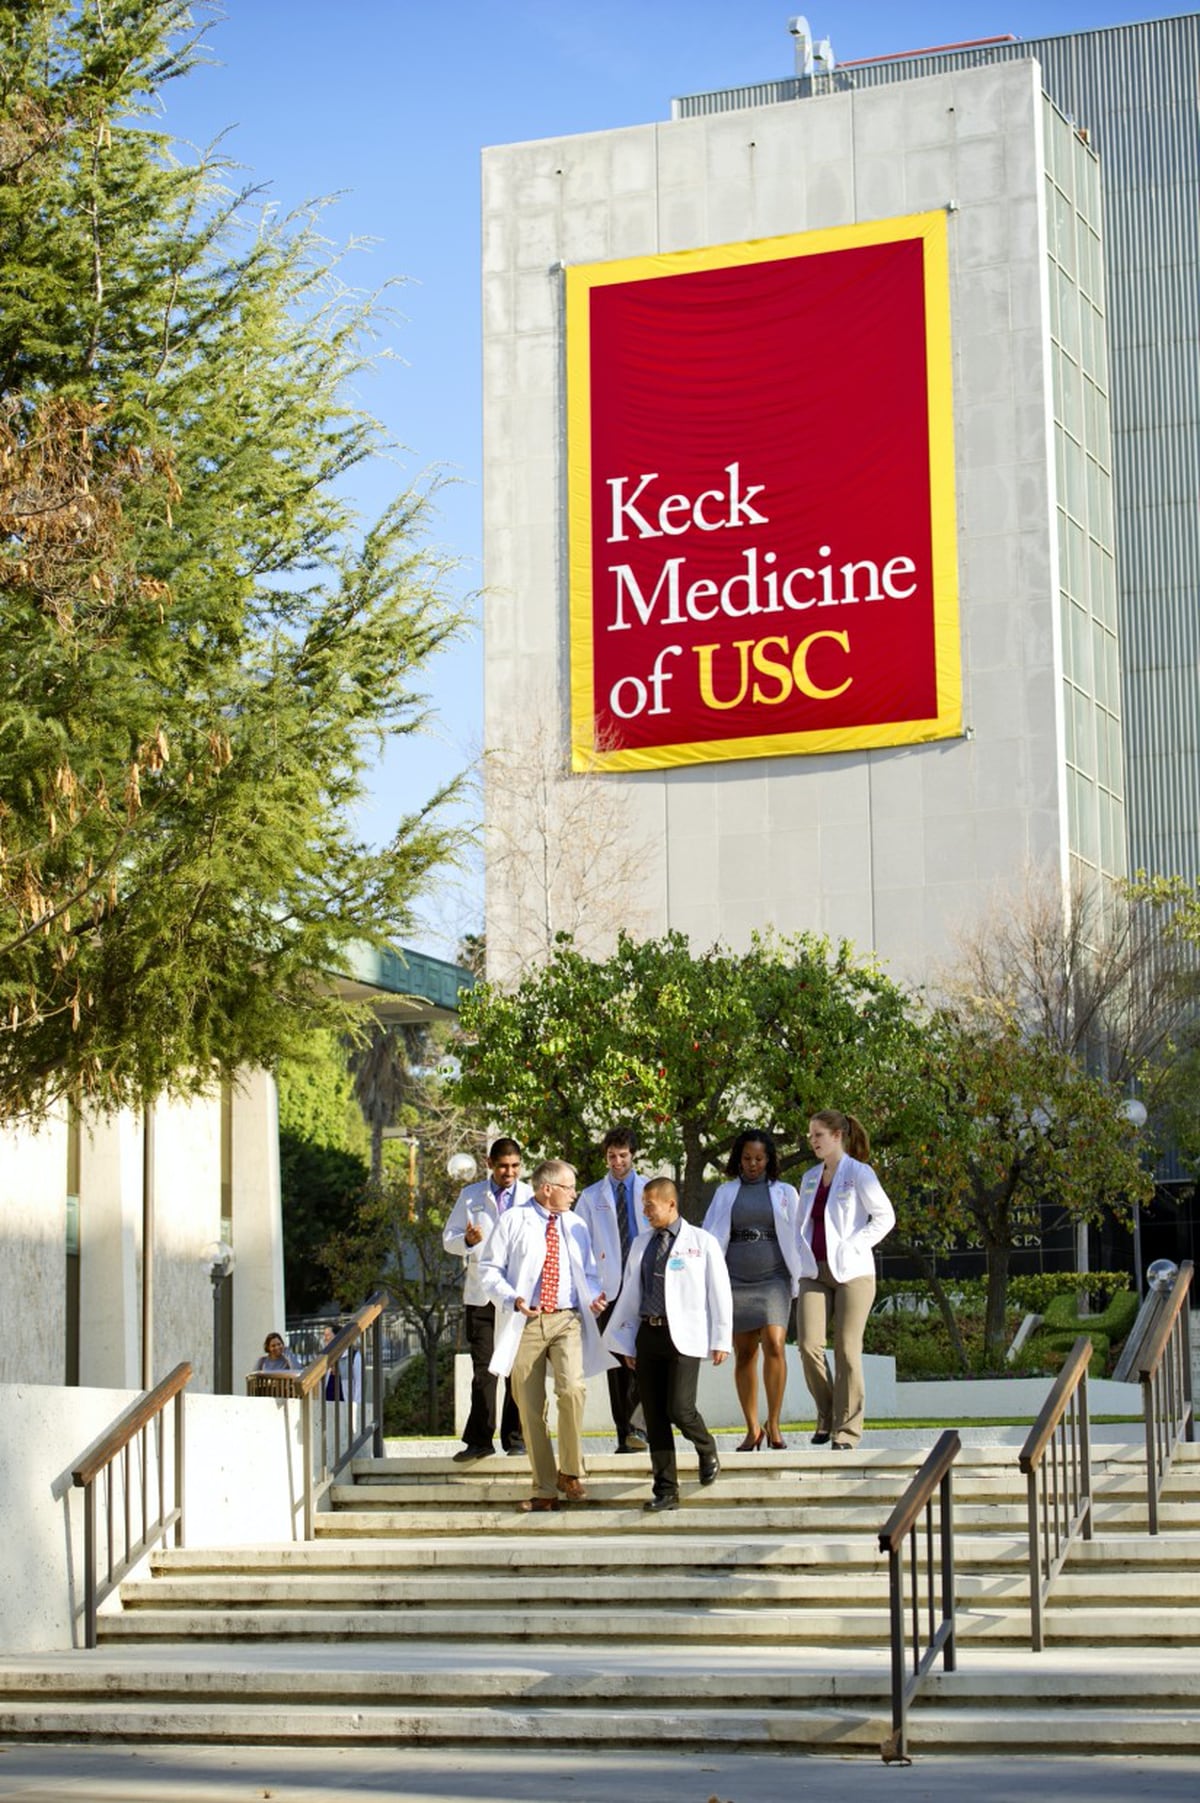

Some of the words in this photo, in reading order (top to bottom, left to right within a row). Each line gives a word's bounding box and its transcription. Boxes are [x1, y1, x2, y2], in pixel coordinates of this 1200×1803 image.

[606, 462, 769, 543] Keck
[607, 545, 917, 631] Medicine
[609, 645, 683, 719] of
[692, 630, 853, 710] USC
